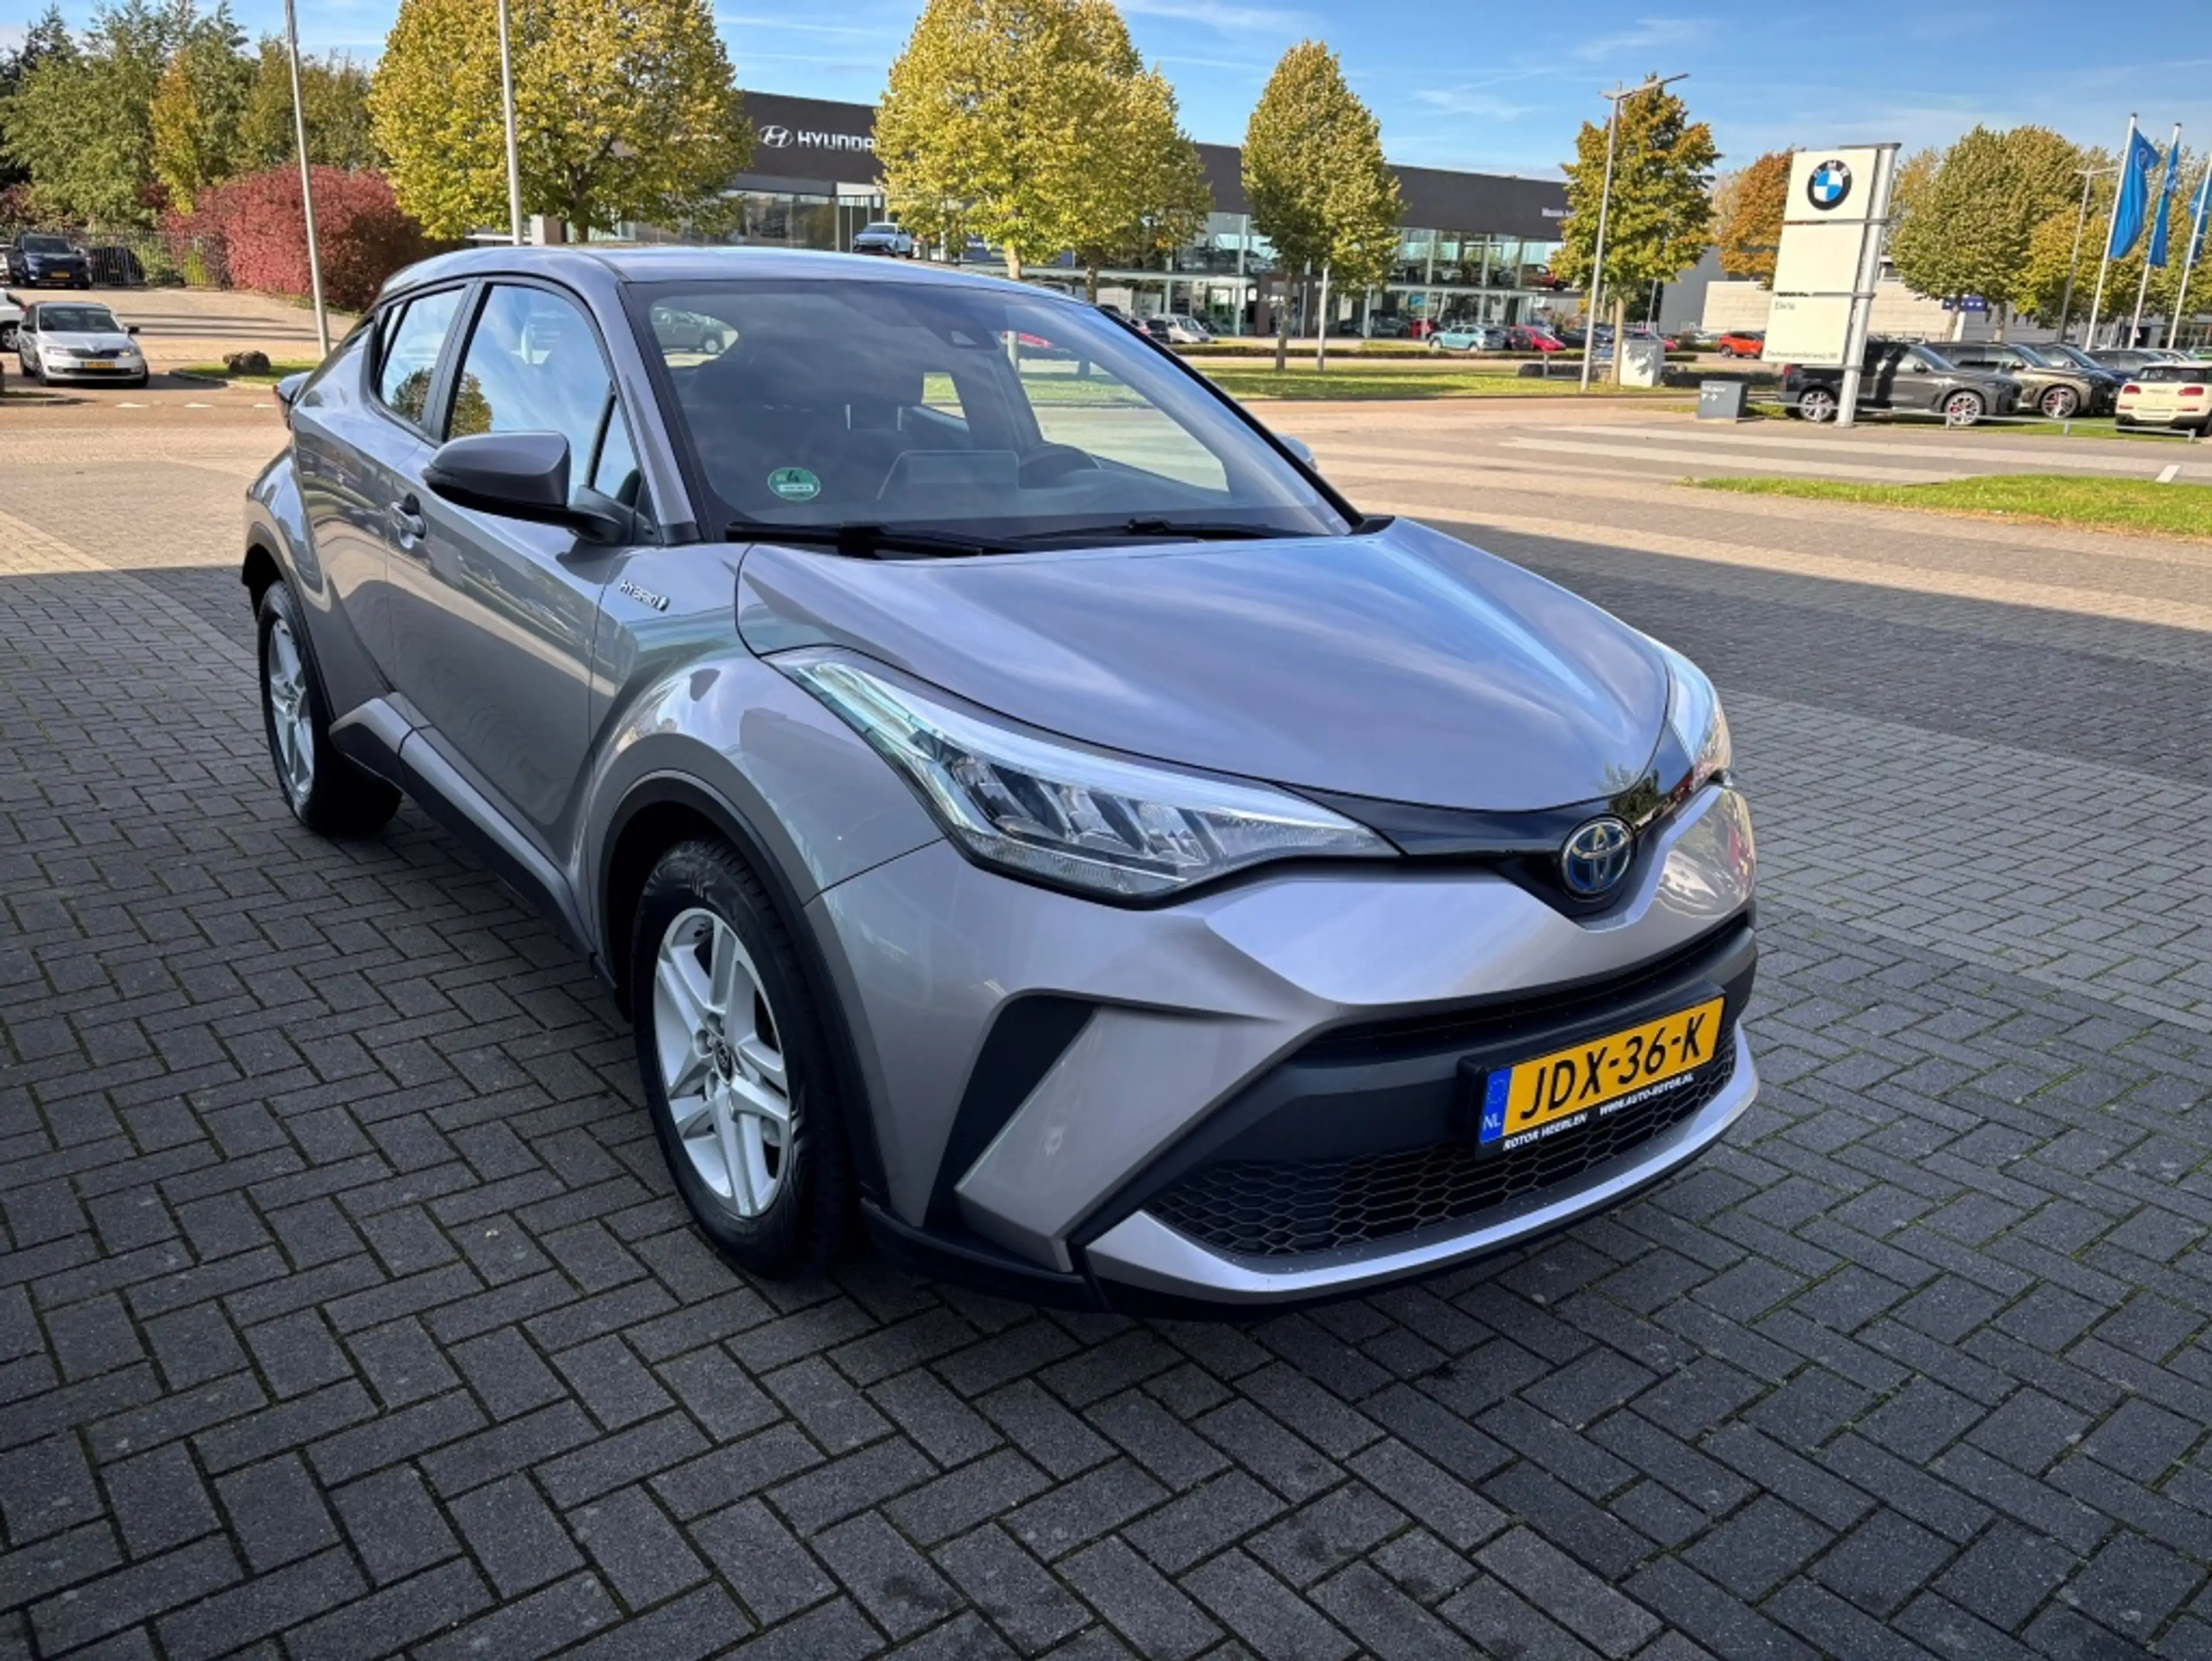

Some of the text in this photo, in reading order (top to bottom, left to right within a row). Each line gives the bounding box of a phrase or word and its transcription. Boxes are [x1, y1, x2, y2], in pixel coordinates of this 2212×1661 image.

[797, 130, 875, 153] HYUNDA
[1520, 1012, 1707, 1119] JDX-36-K
[1482, 1114, 1502, 1130] NL
[1502, 1129, 1540, 1151] ROTOR
[1541, 1113, 1589, 1137] HEERLEN
